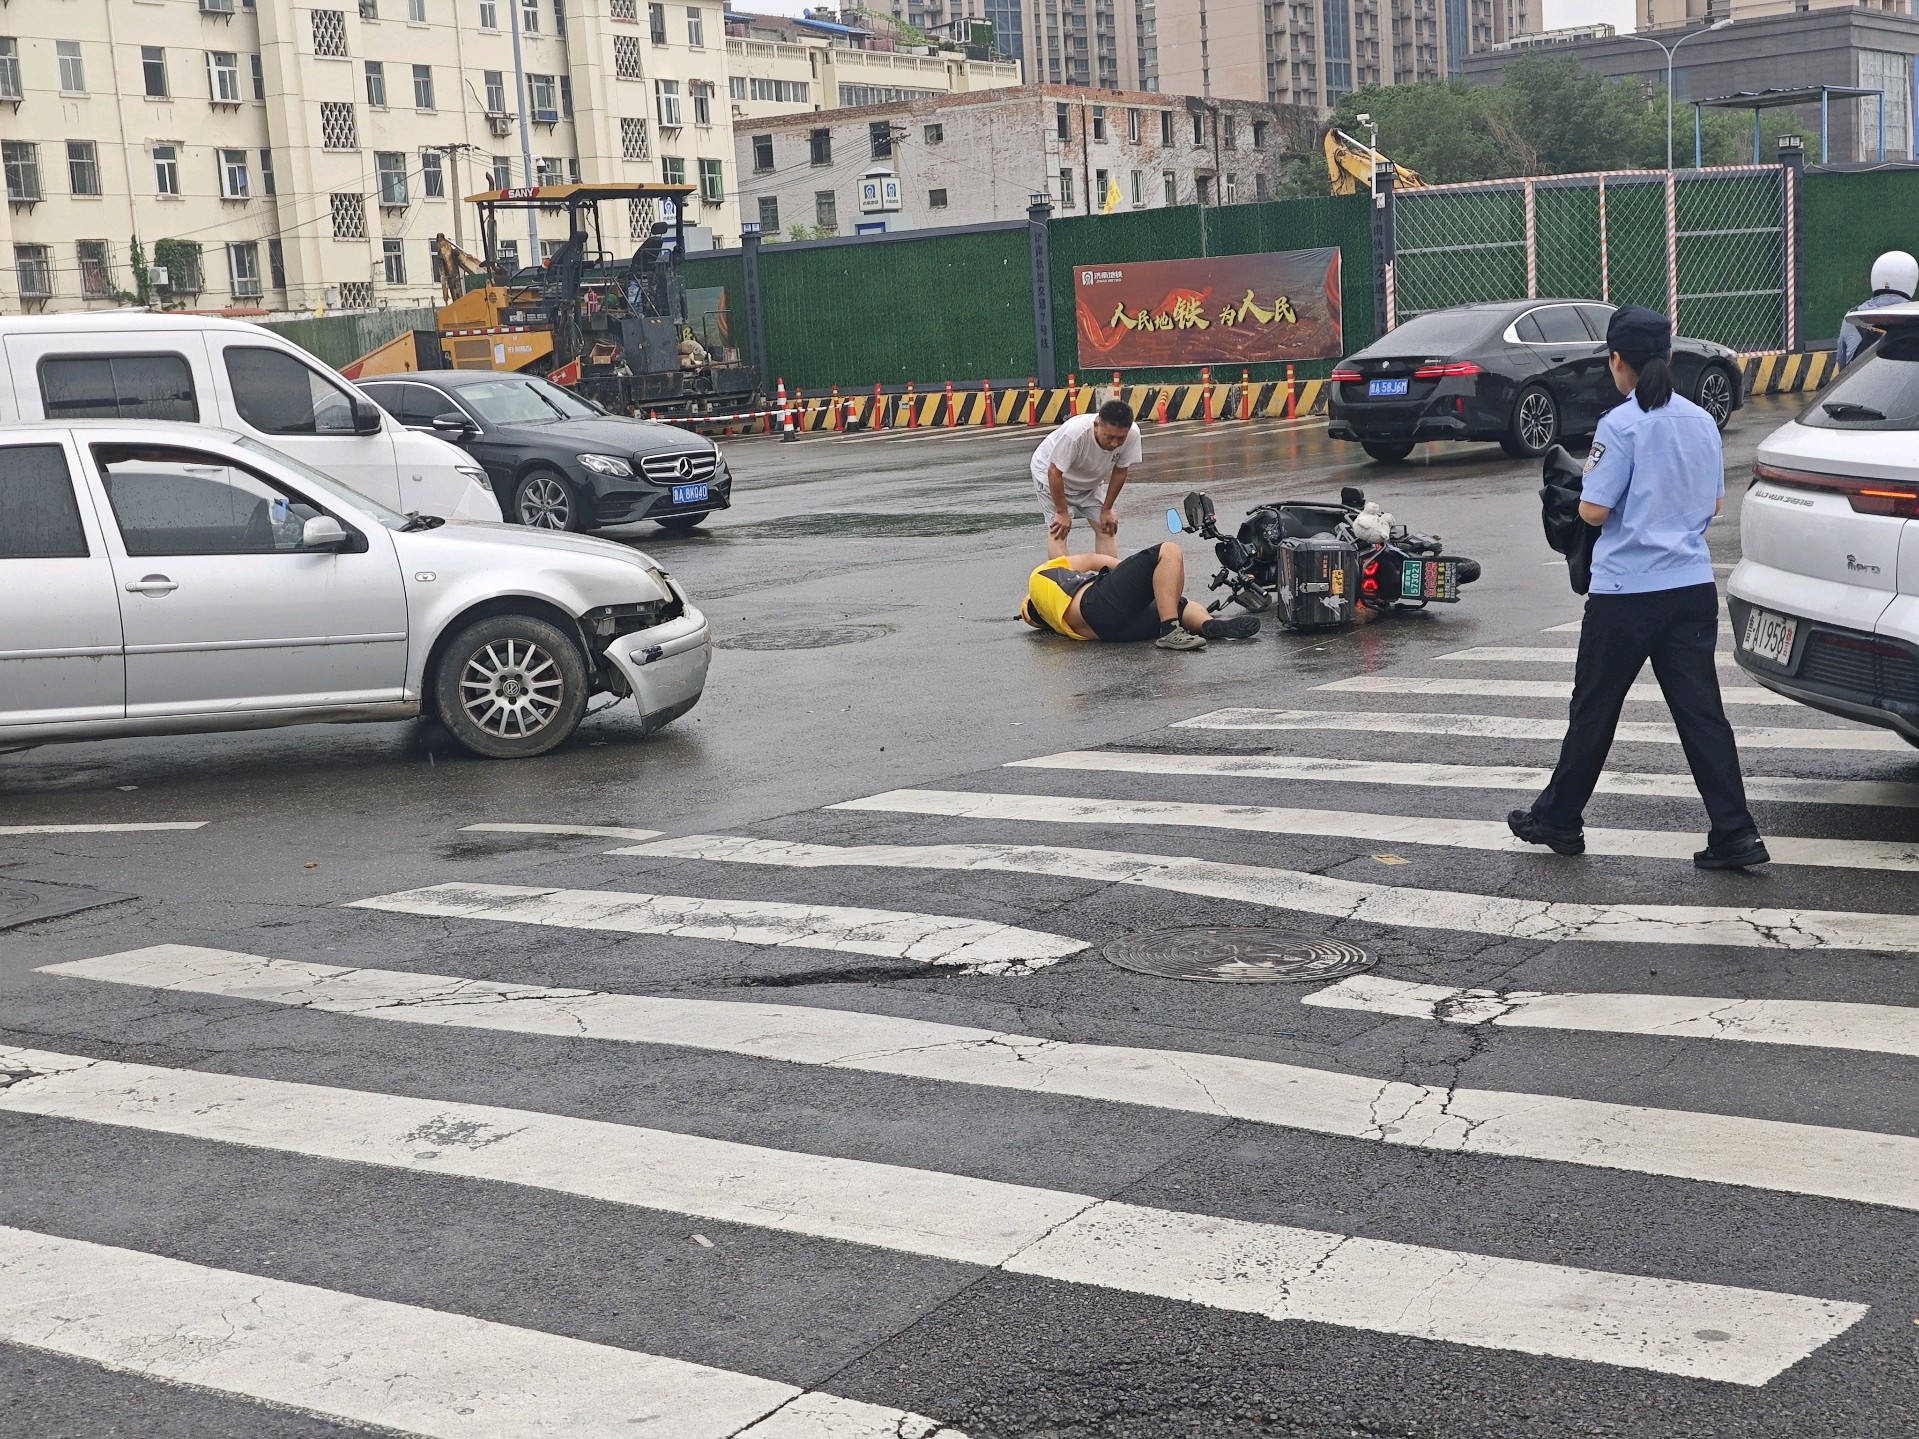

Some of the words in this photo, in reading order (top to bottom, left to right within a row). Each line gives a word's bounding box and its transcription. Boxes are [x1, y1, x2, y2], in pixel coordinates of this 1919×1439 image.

[507, 187, 535, 199] SANY
[1110, 295, 1210, 332] 人民地铁
[1219, 288, 1297, 327] 为人民
[1410, 563, 1420, 594] 573021
